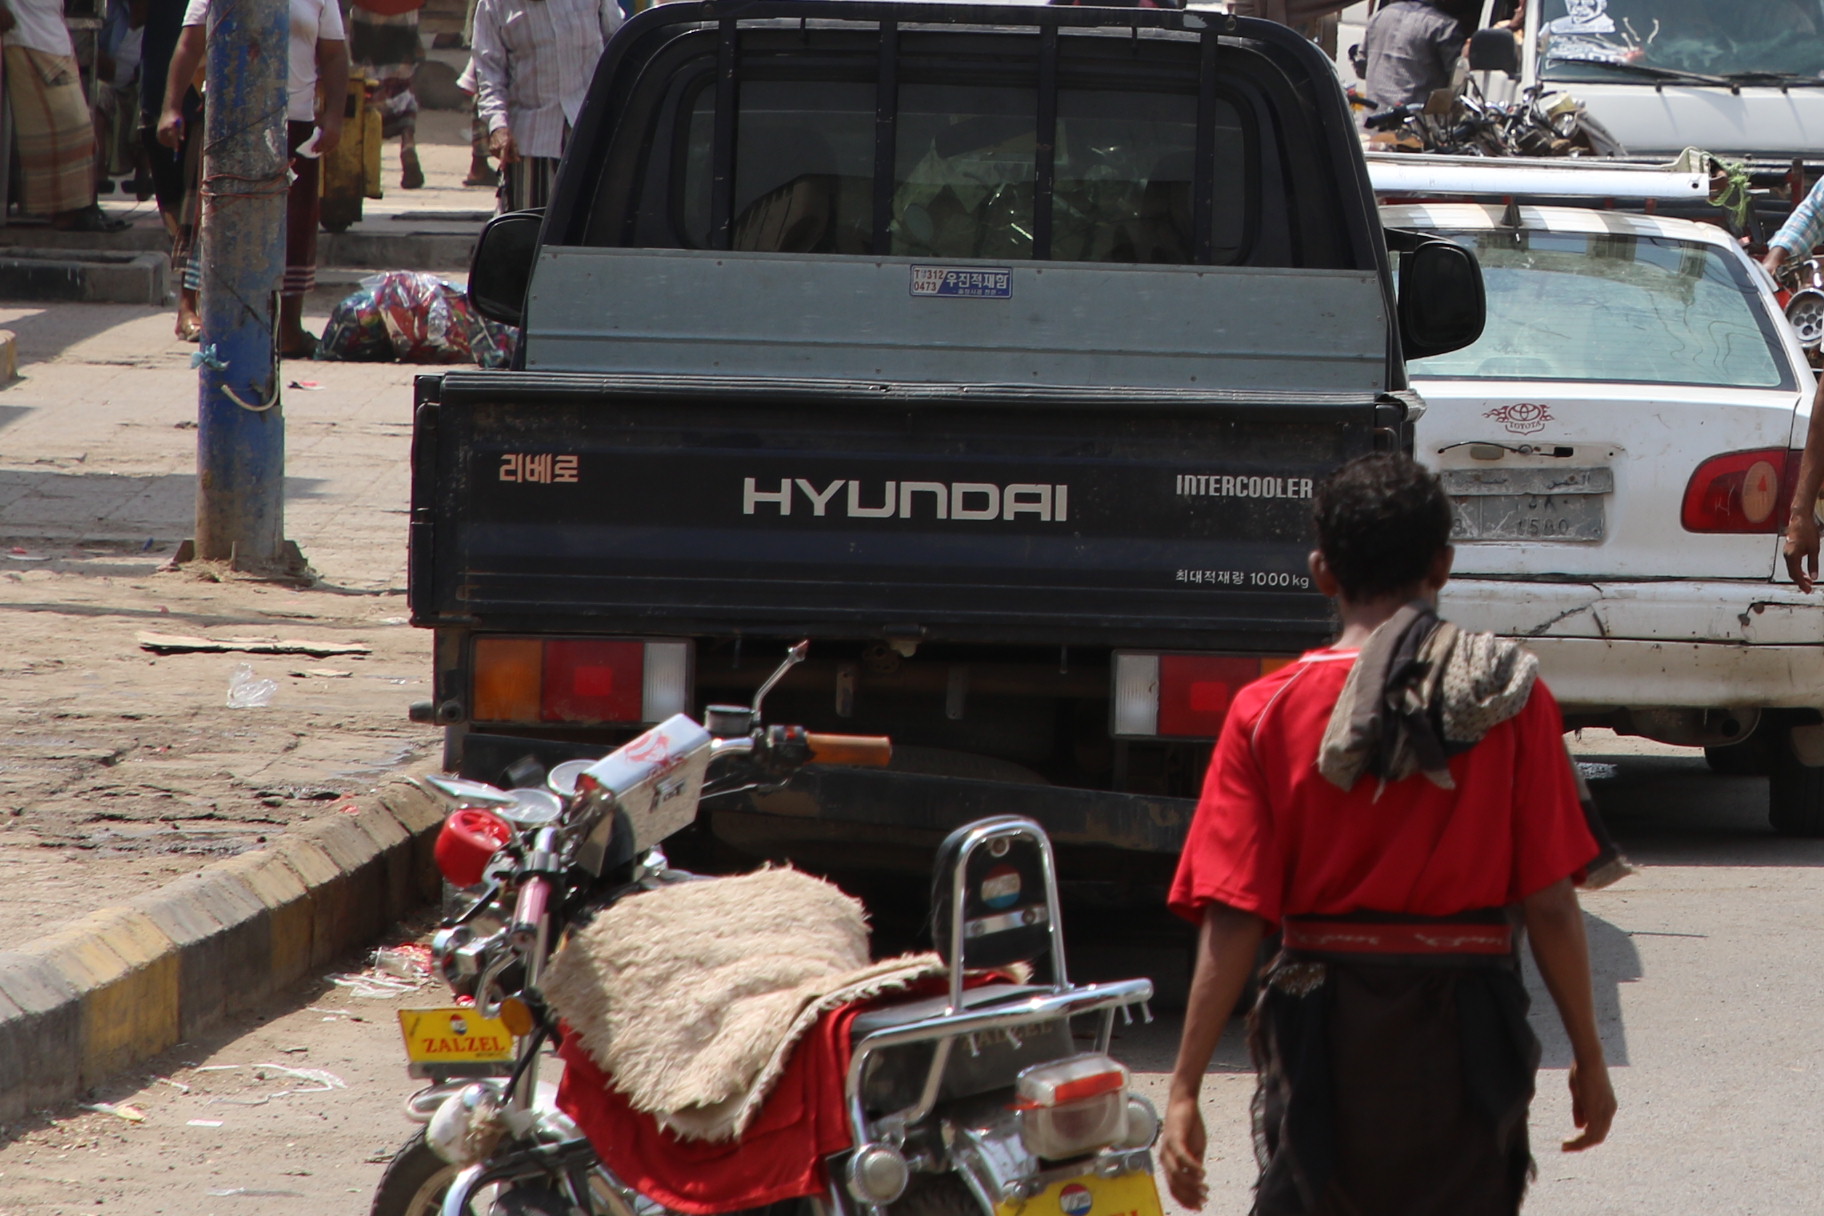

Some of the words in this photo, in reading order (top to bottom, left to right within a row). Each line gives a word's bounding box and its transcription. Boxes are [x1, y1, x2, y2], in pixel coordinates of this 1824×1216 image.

[915, 282, 936, 291] 0473
[946, 273, 1008, 289] 우진적재함
[1508, 421, 1540, 430] TOYOTA
[499, 453, 579, 484] 리베로
[1176, 474, 1313, 499] INTERCOOLER
[743, 477, 1068, 522] HYUNDAI
[1175, 569, 1244, 585] 최대적재량
[423, 1037, 505, 1054] ZALZEL
